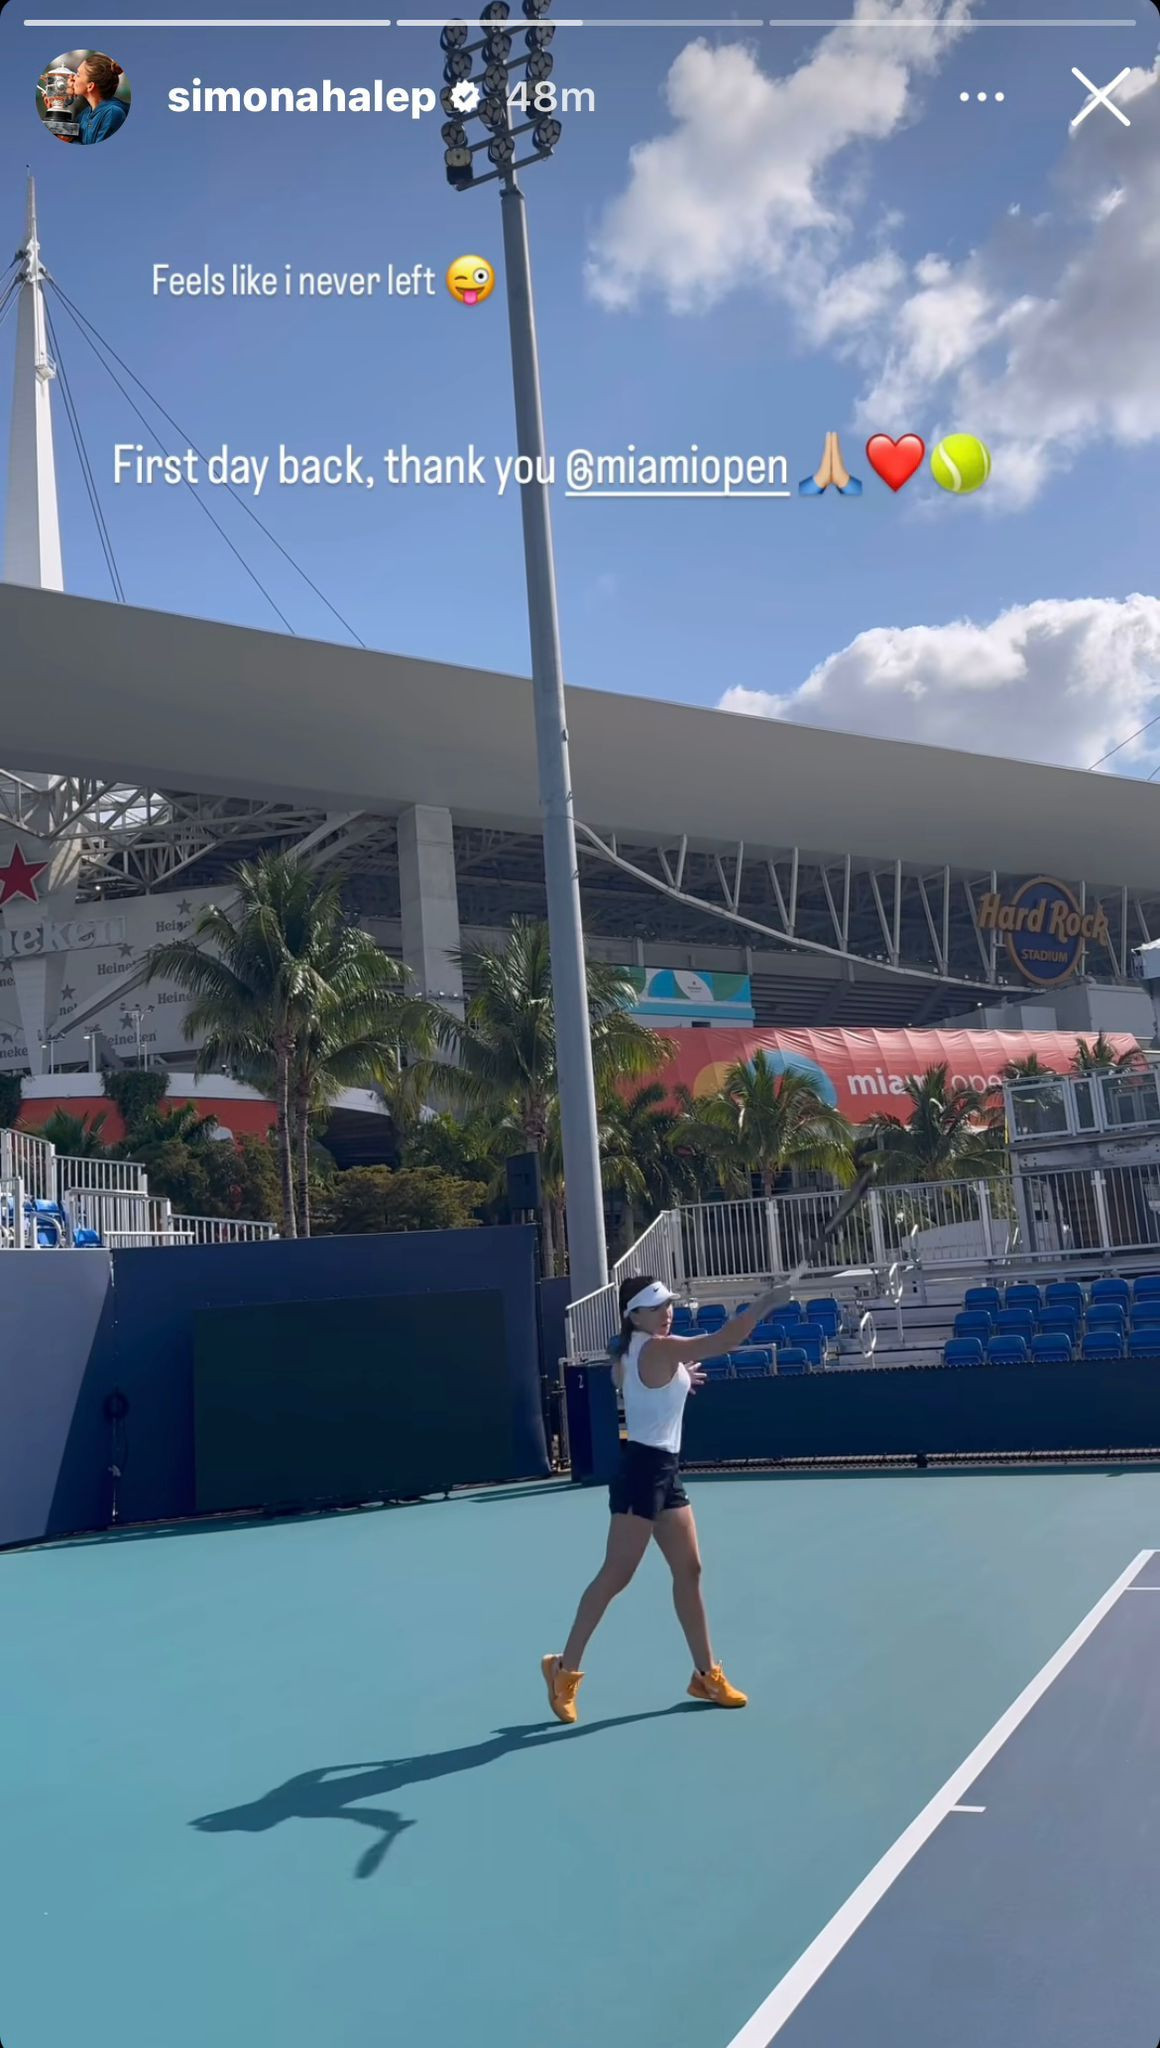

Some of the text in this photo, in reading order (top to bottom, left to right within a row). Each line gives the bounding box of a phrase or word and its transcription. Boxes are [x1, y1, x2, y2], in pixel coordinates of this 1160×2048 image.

[978, 893, 1109, 947] Hard Rock
[1022, 949, 1068, 963] STADIUM
